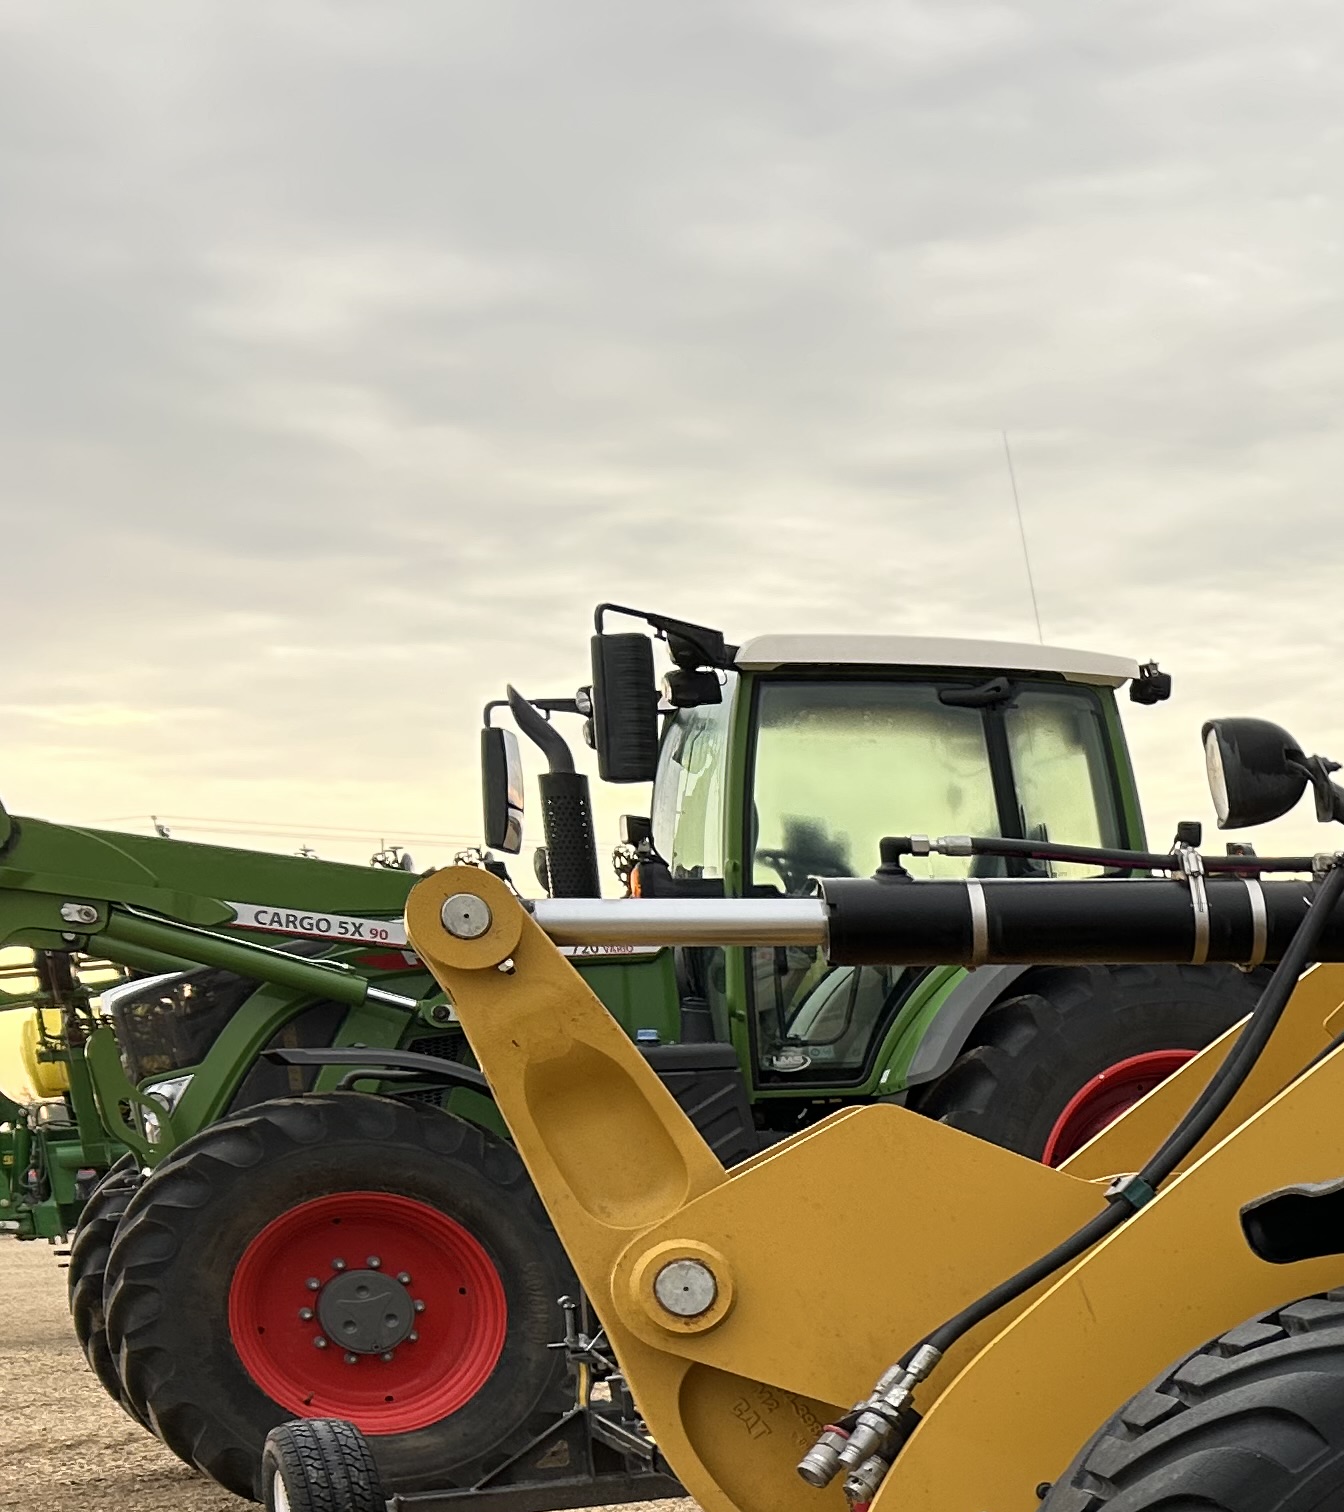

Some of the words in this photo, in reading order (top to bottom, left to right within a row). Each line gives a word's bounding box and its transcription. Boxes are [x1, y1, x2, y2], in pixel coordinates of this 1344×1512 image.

[254, 909, 331, 933] CARGO
[337, 921, 365, 938] 5X
[368, 928, 389, 941] 90
[731, 1397, 773, 1440] CAT
